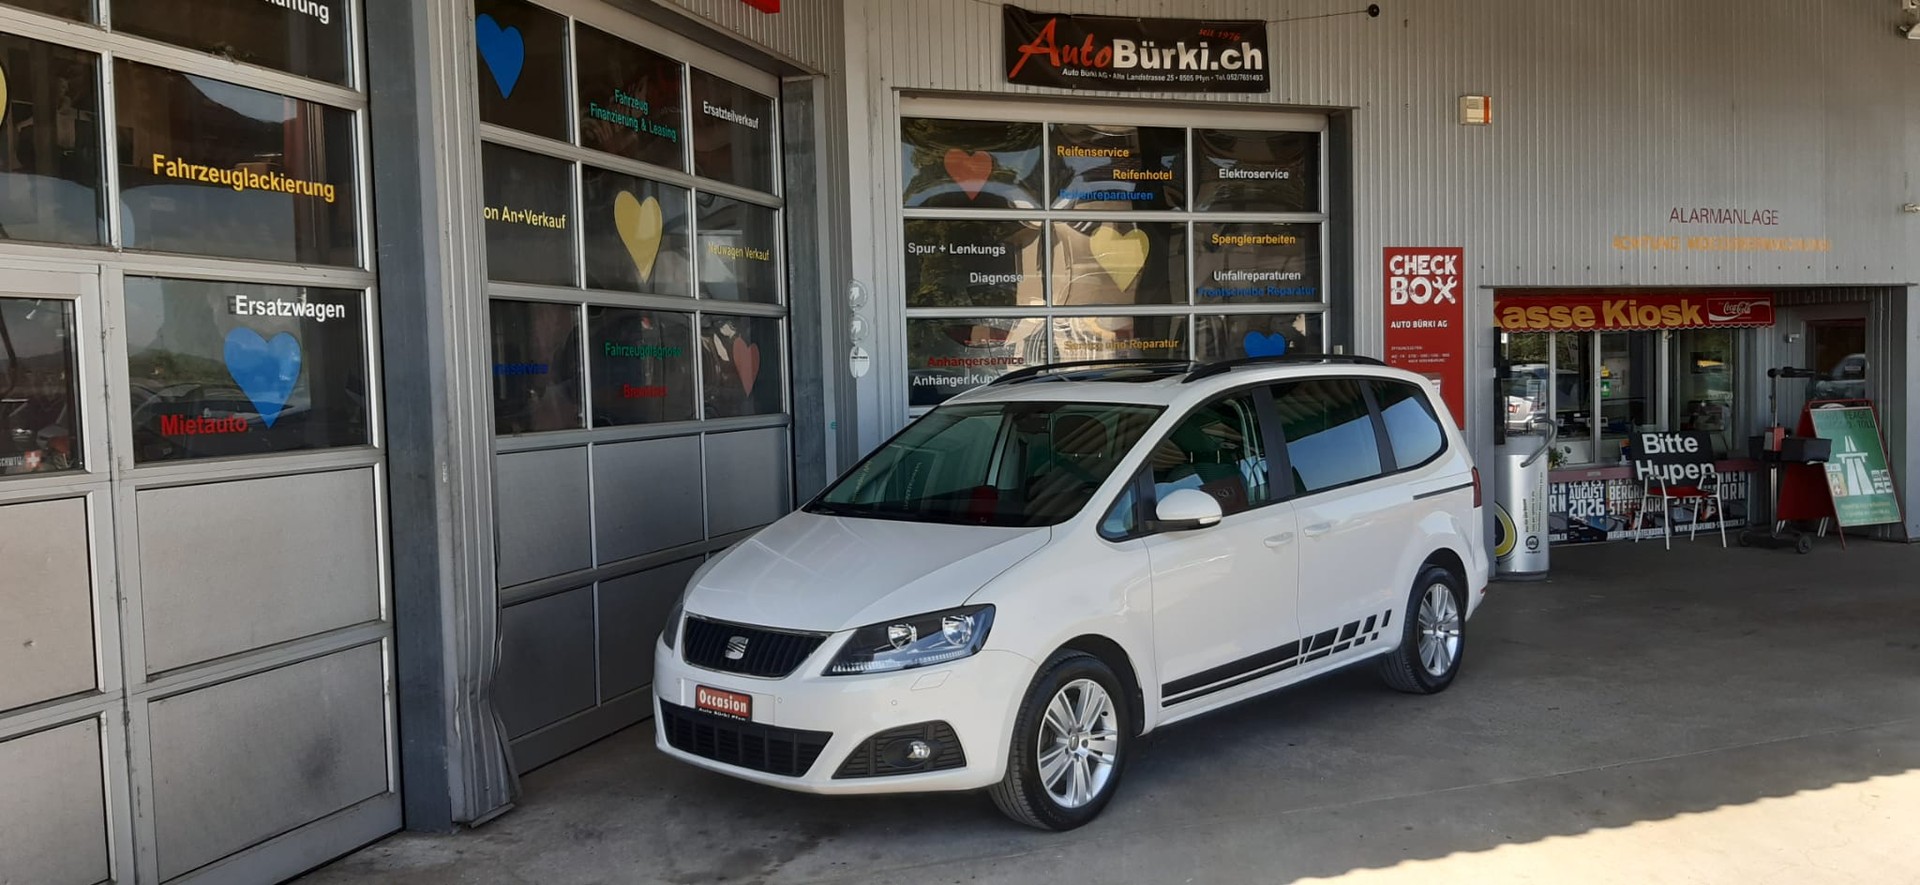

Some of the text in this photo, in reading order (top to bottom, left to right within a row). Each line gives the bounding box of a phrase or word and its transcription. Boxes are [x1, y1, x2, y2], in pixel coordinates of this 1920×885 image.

[1062, 68, 1079, 76] Auto
[1126, 73, 1165, 81] Landstrasse
[614, 89, 649, 115] Fahrzeug
[590, 102, 677, 143] Finanzierung & Leasing
[703, 101, 759, 130] Ersatzteilverkauf
[1056, 145, 1130, 158] Reifenservice
[152, 153, 335, 203] Fahrzeuglackierung
[1112, 169, 1173, 181] Reifenhotel
[1218, 168, 1289, 180] Elektroservice
[1669, 207, 1779, 226] ALARMANLAGE
[907, 242, 936, 255] Spur
[949, 243, 1006, 257] Lenkungs
[1211, 233, 1296, 247] Spenglerarbeiten
[708, 241, 770, 262] Neuwagen Verkauf
[1389, 254, 1458, 275] CHECK
[969, 272, 1024, 286] Diagnose
[1213, 270, 1302, 283] Unfallreparaturen
[1390, 275, 1458, 305] BOX
[235, 294, 346, 322] Ersatzwagen
[1602, 298, 1704, 328] Kiosk
[1390, 318, 1448, 329] AUTO BÜRKI AG
[1129, 339, 1179, 352] Reparatur
[927, 354, 1025, 368] Anhängerservice
[912, 374, 970, 388] Anhänger
[160, 414, 249, 437] Mietauto
[1641, 431, 1700, 455] Bitte
[1634, 458, 1716, 486] Hupen
[1568, 486, 1605, 500] AUGUST
[1568, 498, 1605, 518] 2026
[699, 689, 747, 714] Occasion
